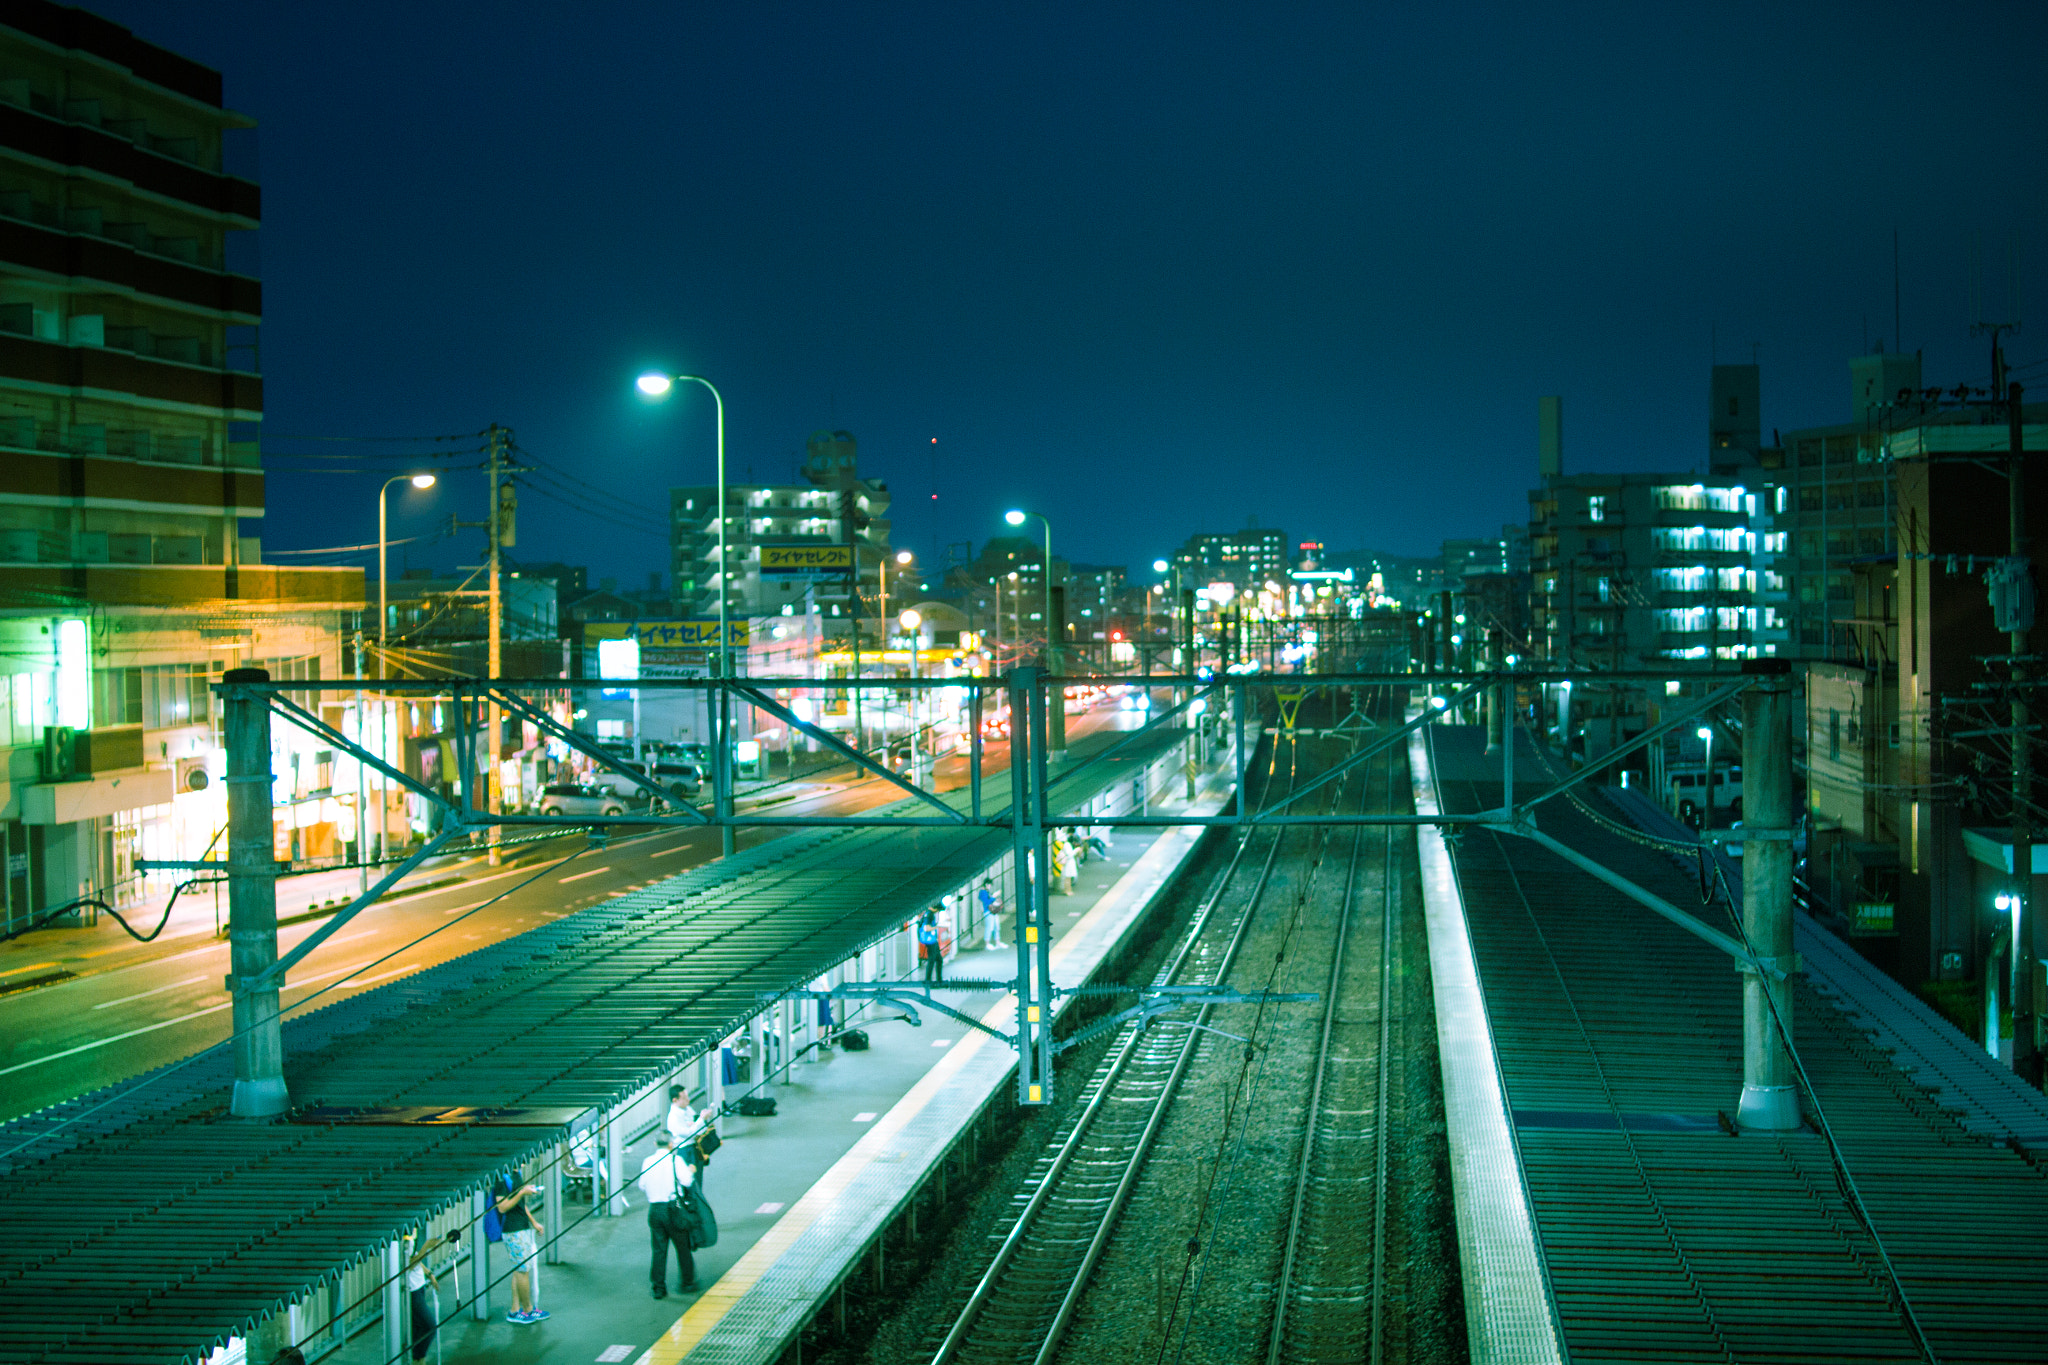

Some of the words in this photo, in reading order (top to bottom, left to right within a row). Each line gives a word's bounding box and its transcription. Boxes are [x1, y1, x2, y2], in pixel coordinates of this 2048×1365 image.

[769, 550, 847, 563] タイヤセレクト
